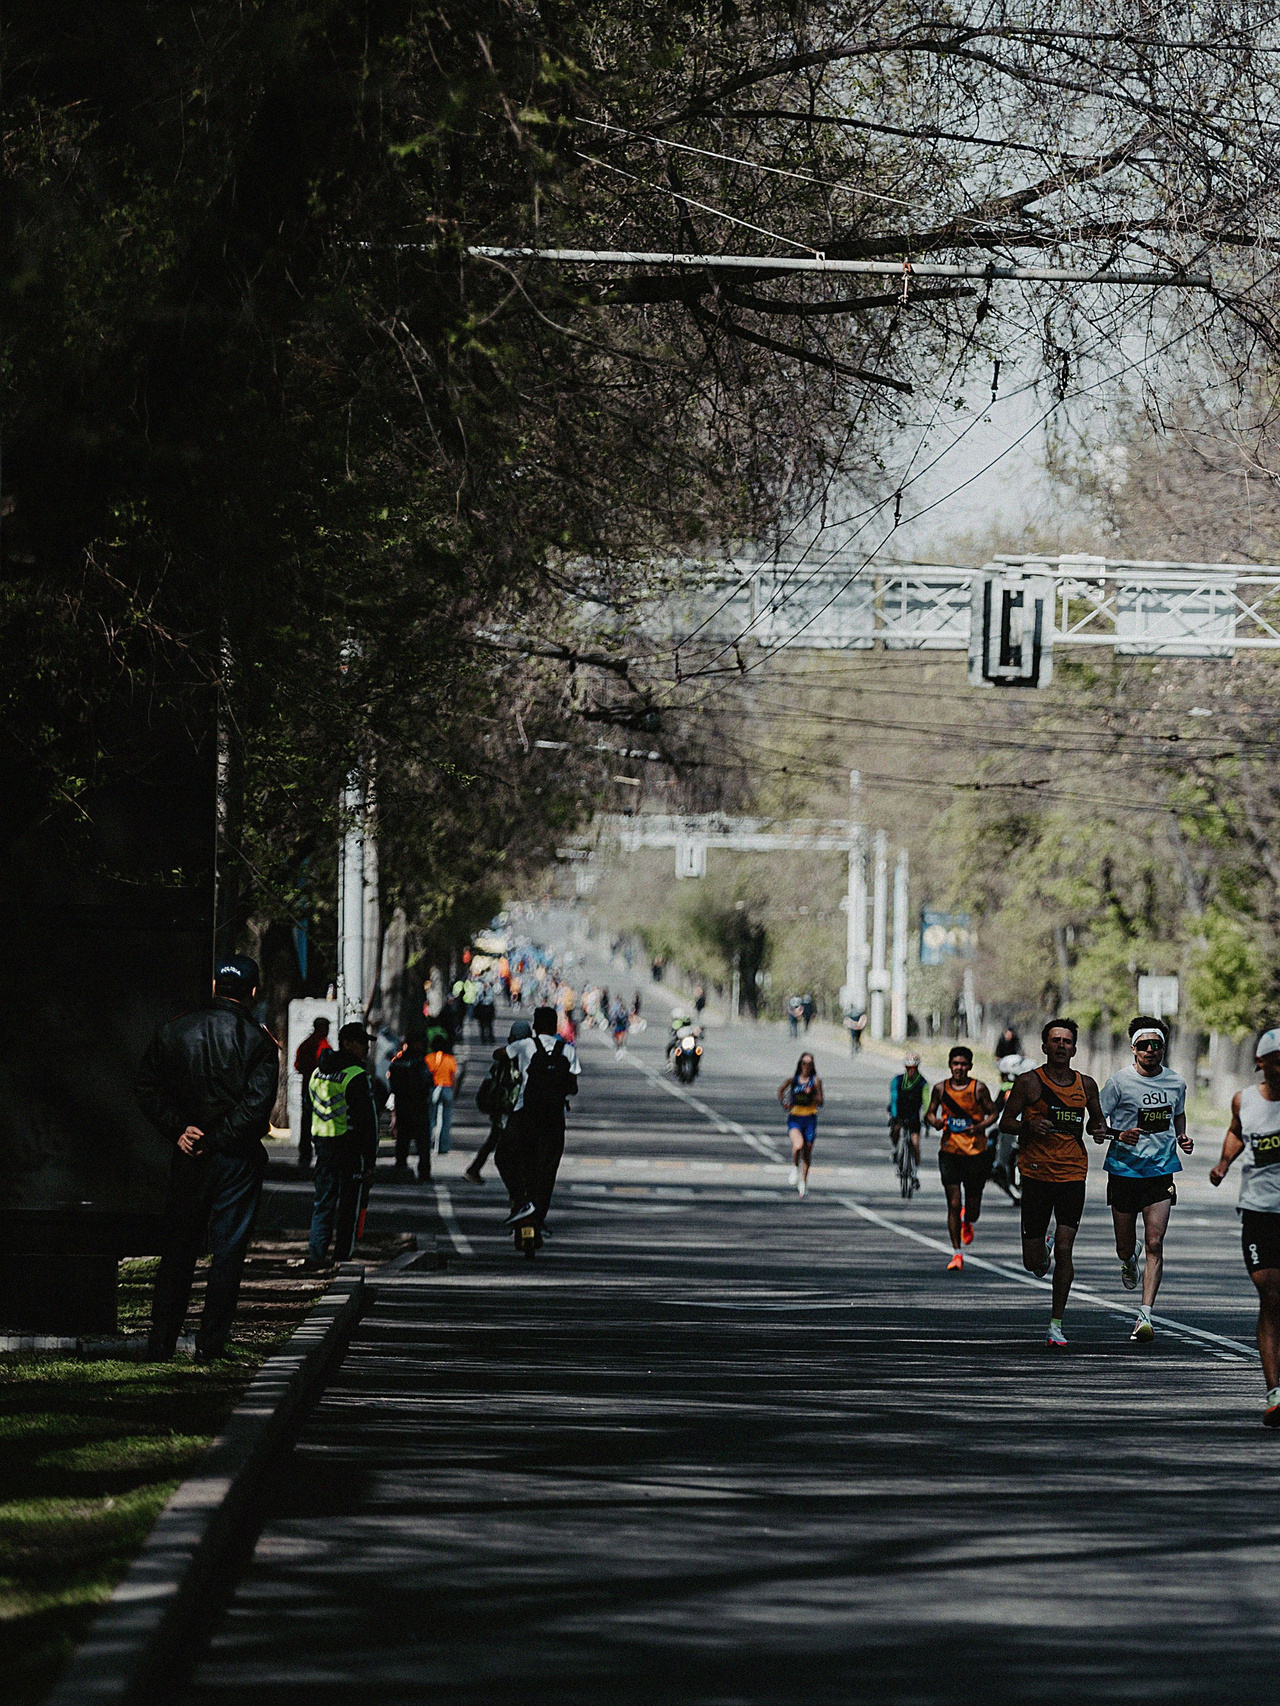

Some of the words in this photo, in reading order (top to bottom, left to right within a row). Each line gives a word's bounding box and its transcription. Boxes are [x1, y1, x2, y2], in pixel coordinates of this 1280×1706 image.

[1142, 1092, 1168, 1105] asu
[1056, 1111, 1077, 1121] 1155
[1143, 1110, 1168, 1121] 7946
